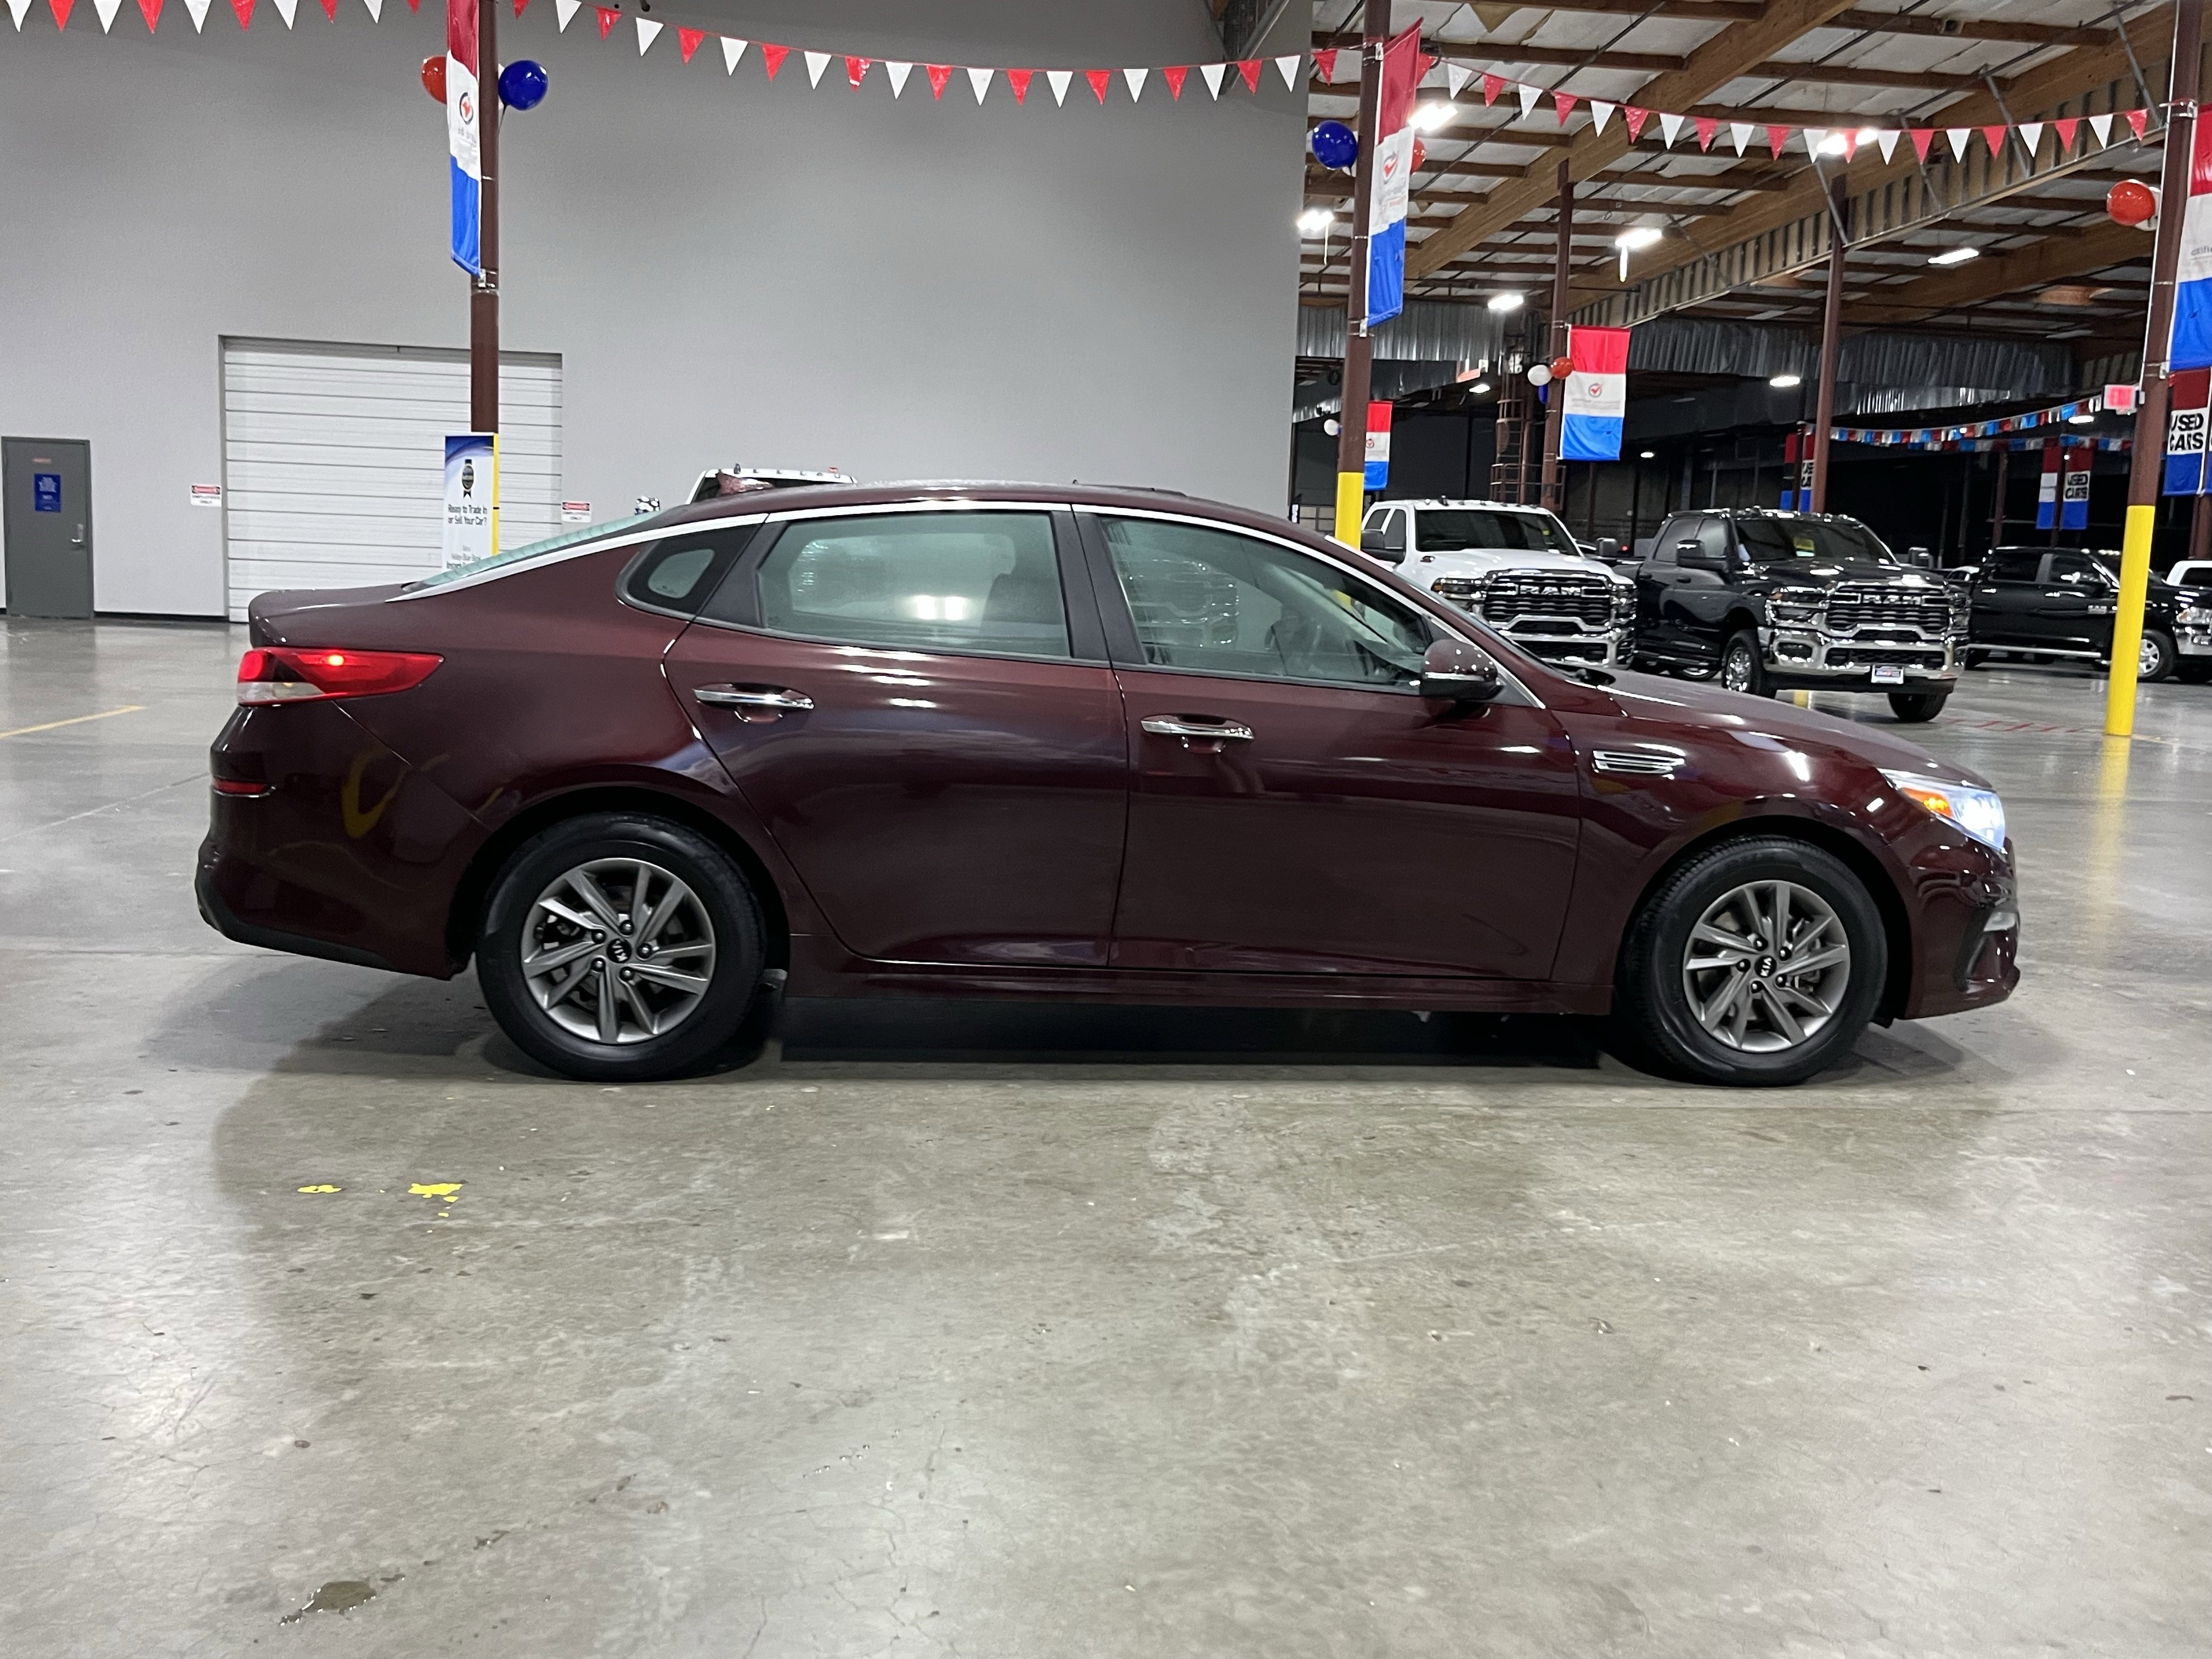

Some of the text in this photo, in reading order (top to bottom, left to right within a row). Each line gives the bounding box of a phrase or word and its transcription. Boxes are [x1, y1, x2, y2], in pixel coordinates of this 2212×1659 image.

[2171, 413, 2204, 432] USED
[2170, 432, 2204, 451] CARS
[469, 504, 481, 514] Trade
[464, 516, 475, 525] Your
[1520, 585, 1581, 596] RAM
[1863, 594, 1921, 605] RAM
[1760, 957, 1772, 977] KIA
